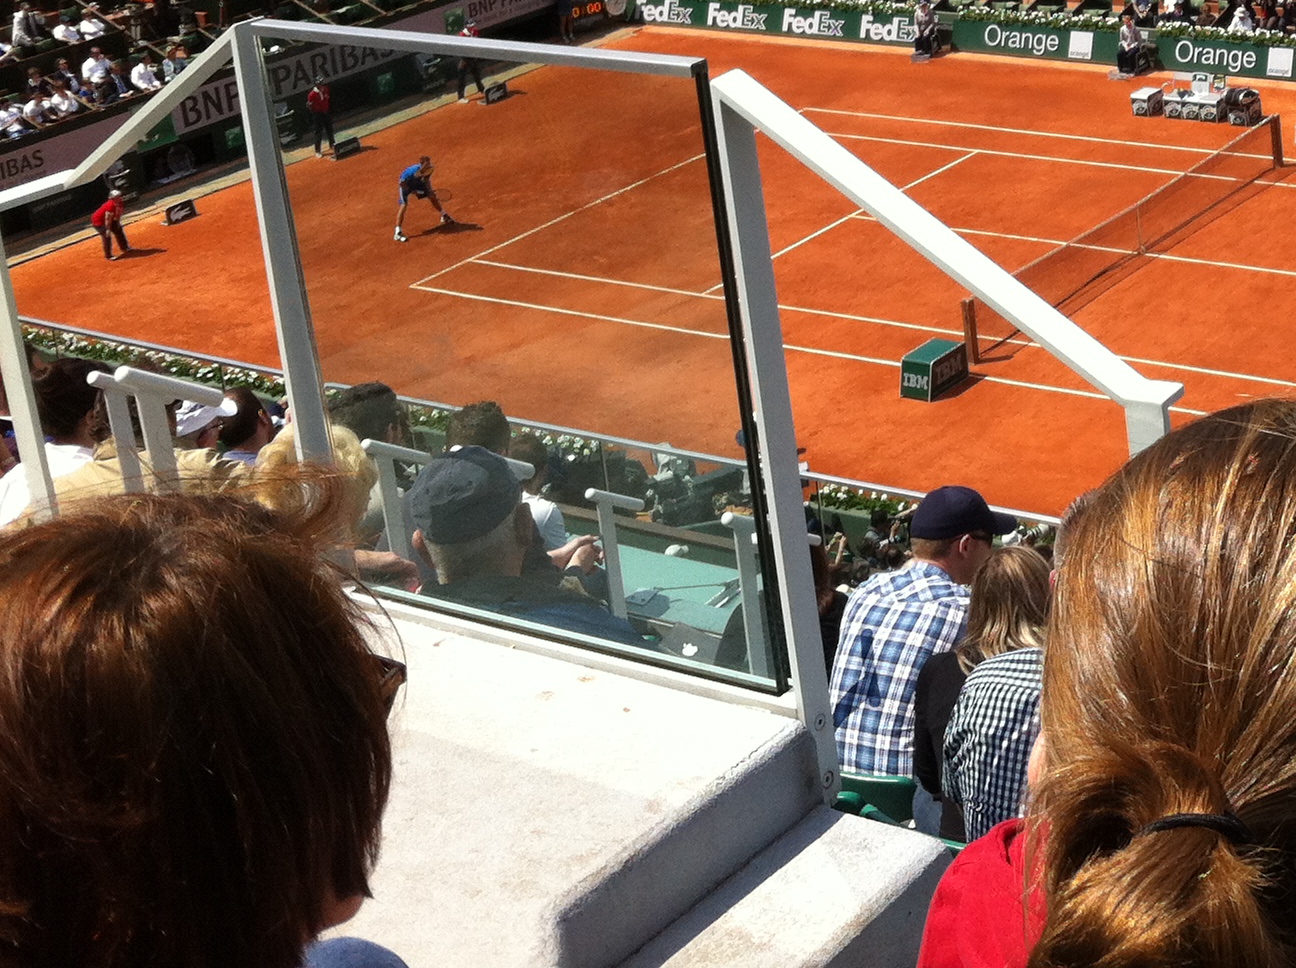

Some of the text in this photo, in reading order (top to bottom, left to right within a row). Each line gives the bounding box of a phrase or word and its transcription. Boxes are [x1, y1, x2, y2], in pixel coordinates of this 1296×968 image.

[707, 2, 768, 30] FedEx
[782, 8, 845, 37] FedEx
[984, 24, 1059, 55] Orange
[1175, 40, 1257, 72] Orange
[903, 372, 929, 390] IBM
